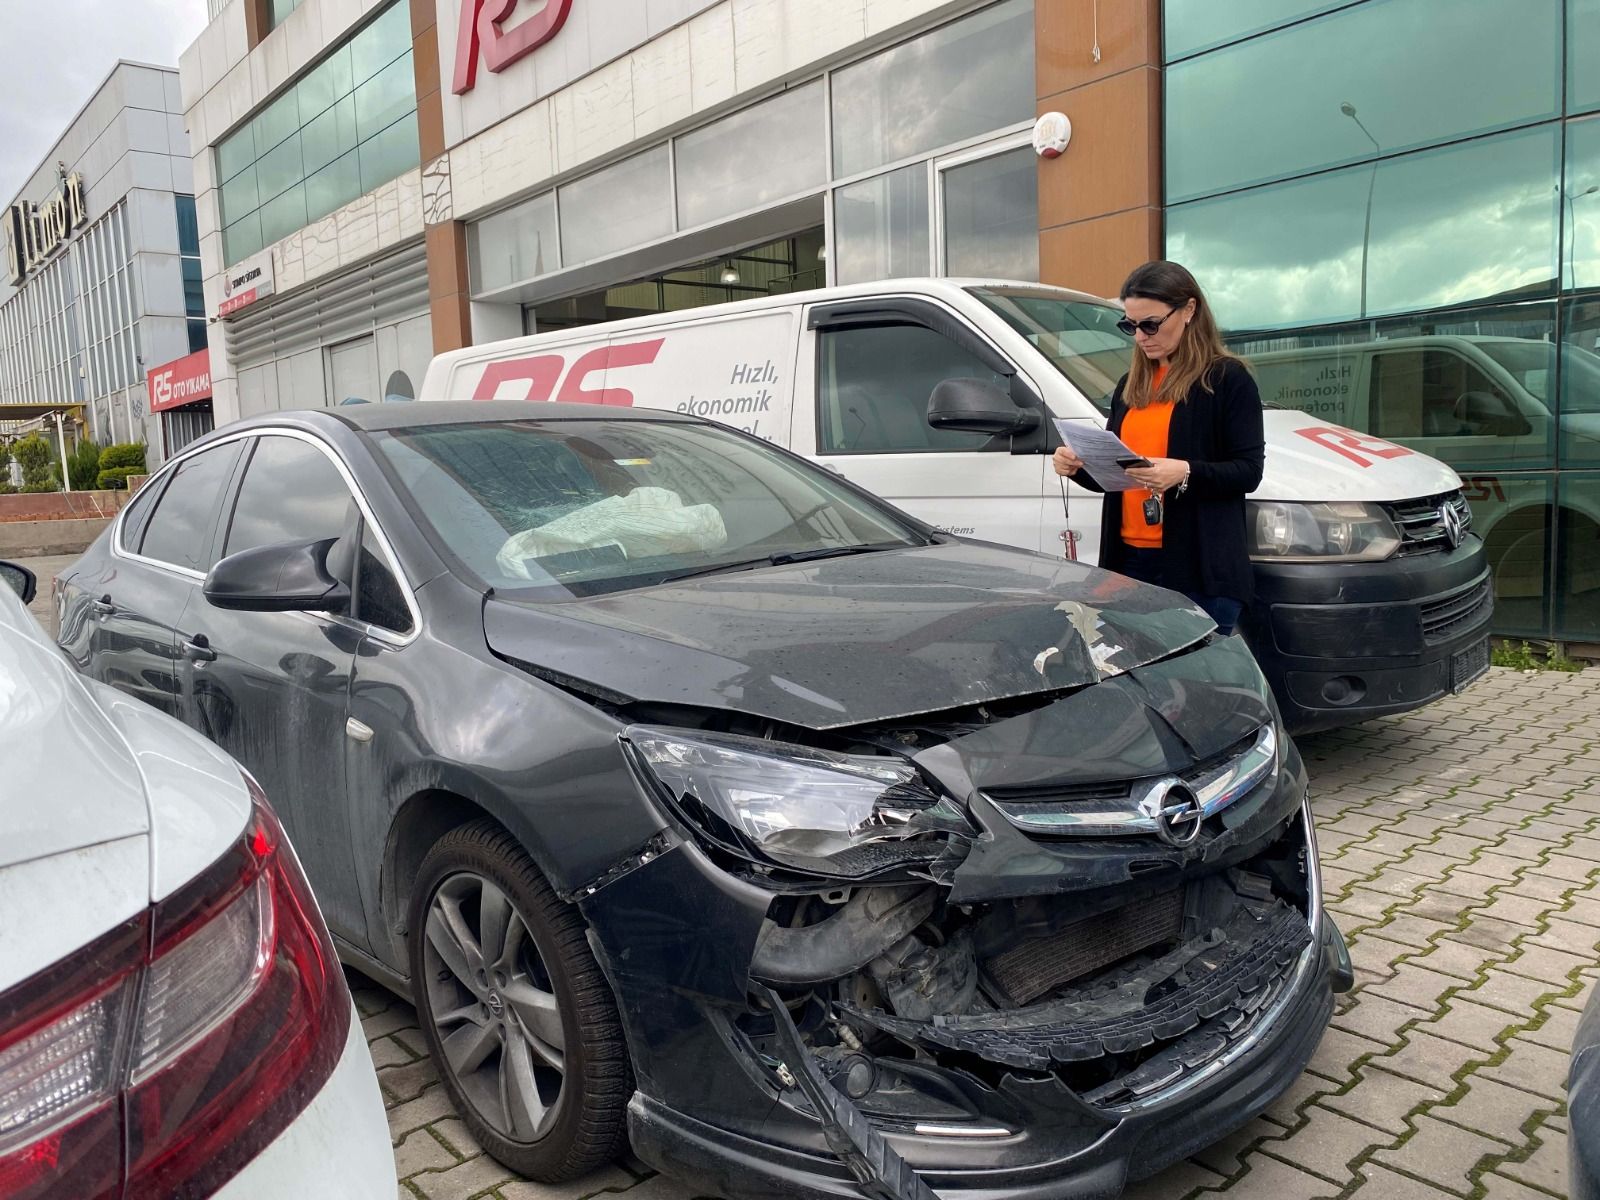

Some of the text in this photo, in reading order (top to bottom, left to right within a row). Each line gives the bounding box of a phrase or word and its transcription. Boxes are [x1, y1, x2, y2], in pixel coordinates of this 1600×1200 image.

[730, 359, 779, 385] Hızlı,
[153, 370, 210, 406] RS OTO YIKAMA
[676, 389, 772, 416] ekonomik
